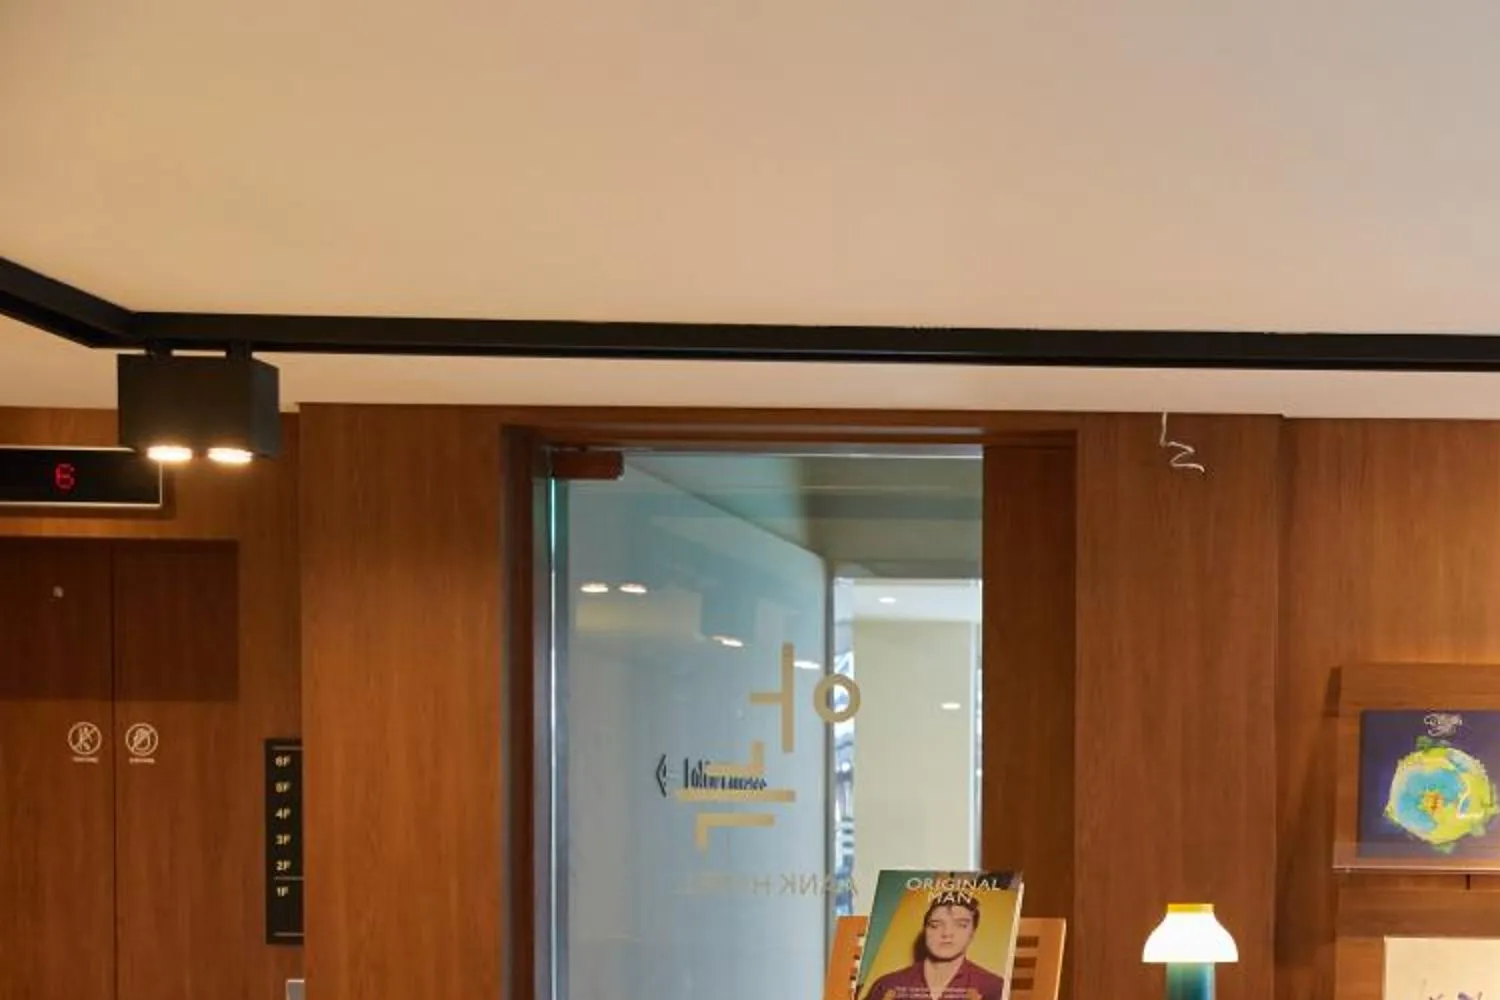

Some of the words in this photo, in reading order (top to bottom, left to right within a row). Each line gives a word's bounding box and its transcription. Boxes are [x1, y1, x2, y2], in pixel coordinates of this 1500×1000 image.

[56, 463, 75, 489] 6
[275, 808, 291, 819] 4F
[275, 834, 291, 845] 3F
[276, 860, 291, 871] 2F
[906, 877, 1001, 891] ORIGINAL
[276, 887, 289, 897] 1F
[928, 891, 974, 904] MAN
